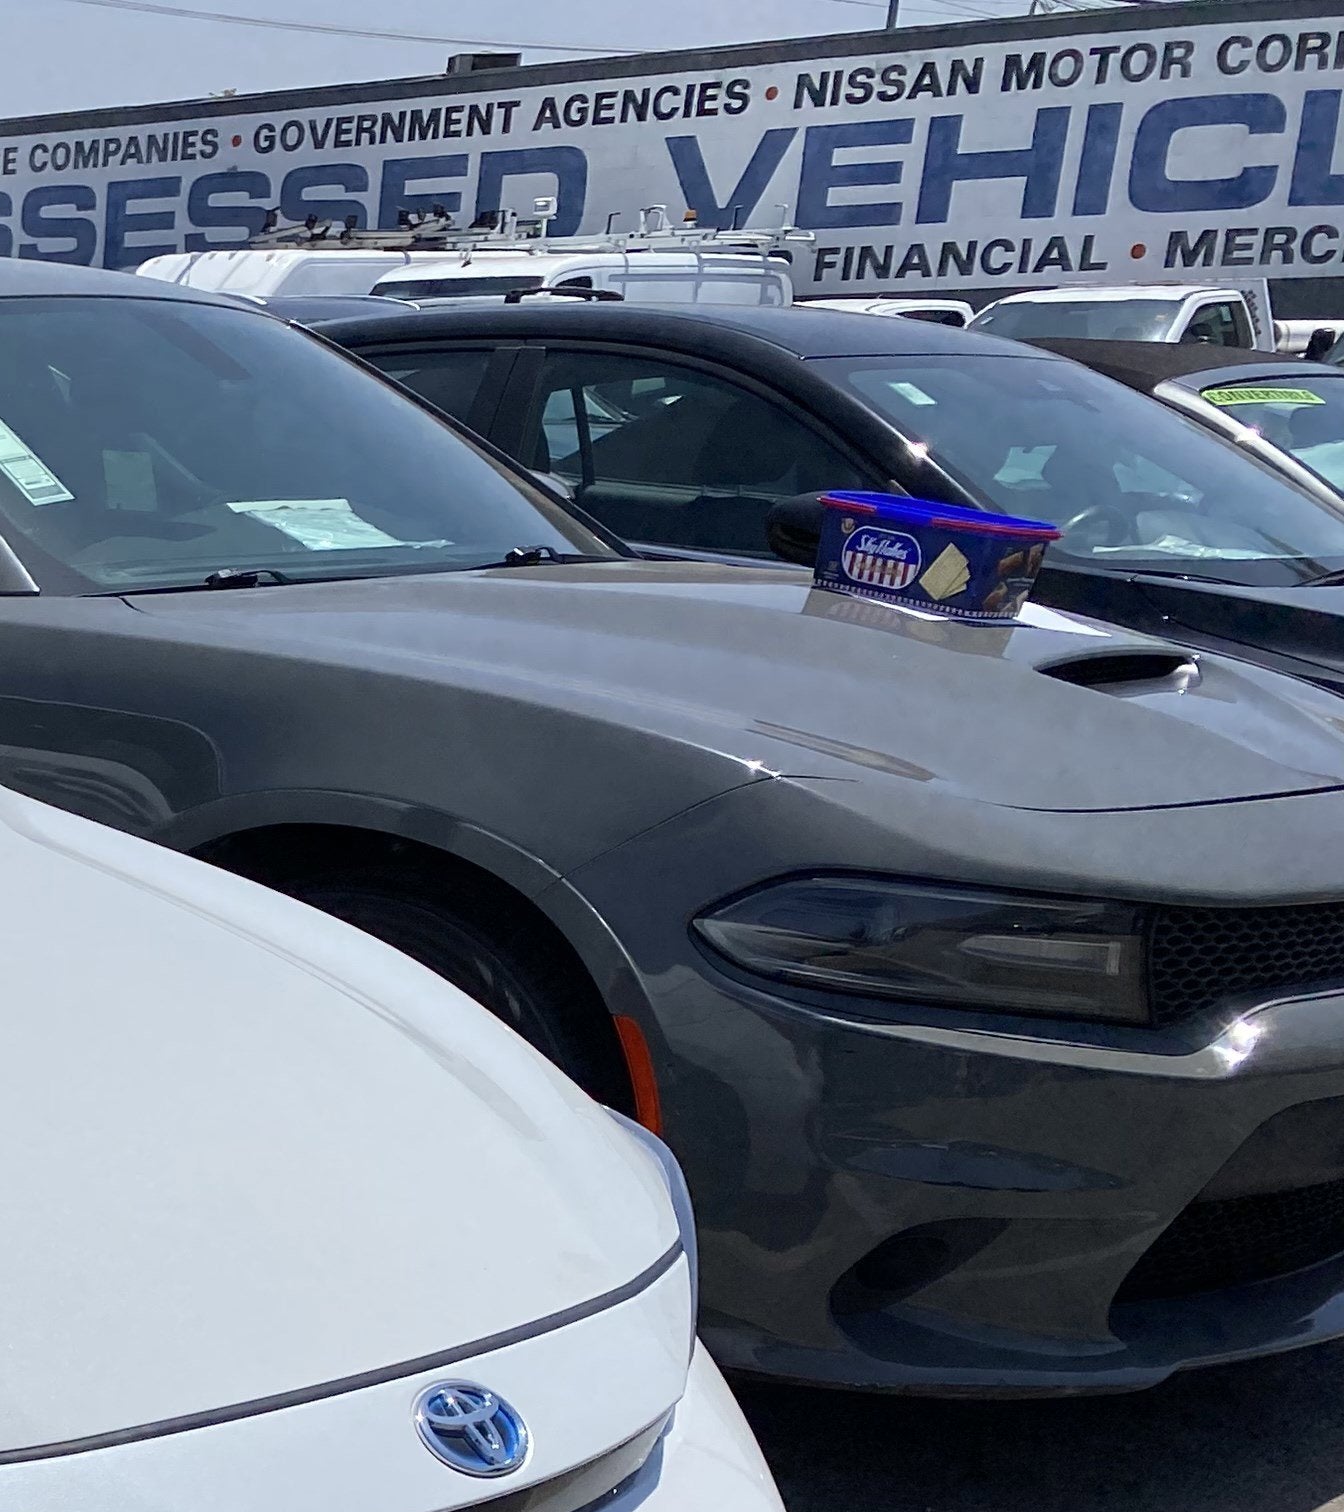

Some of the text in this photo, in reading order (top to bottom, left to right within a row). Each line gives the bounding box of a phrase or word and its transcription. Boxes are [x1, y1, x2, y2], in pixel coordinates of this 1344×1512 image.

[28, 128, 219, 173] COMPANIES
[253, 100, 522, 154] GOVERNMENT
[532, 78, 751, 132] AGENCIES
[793, 57, 984, 109] NISSAN
[1000, 40, 1195, 93] MOTOR
[665, 88, 1344, 231] VEHICL
[813, 224, 1344, 281] FINANCIAL MERC
